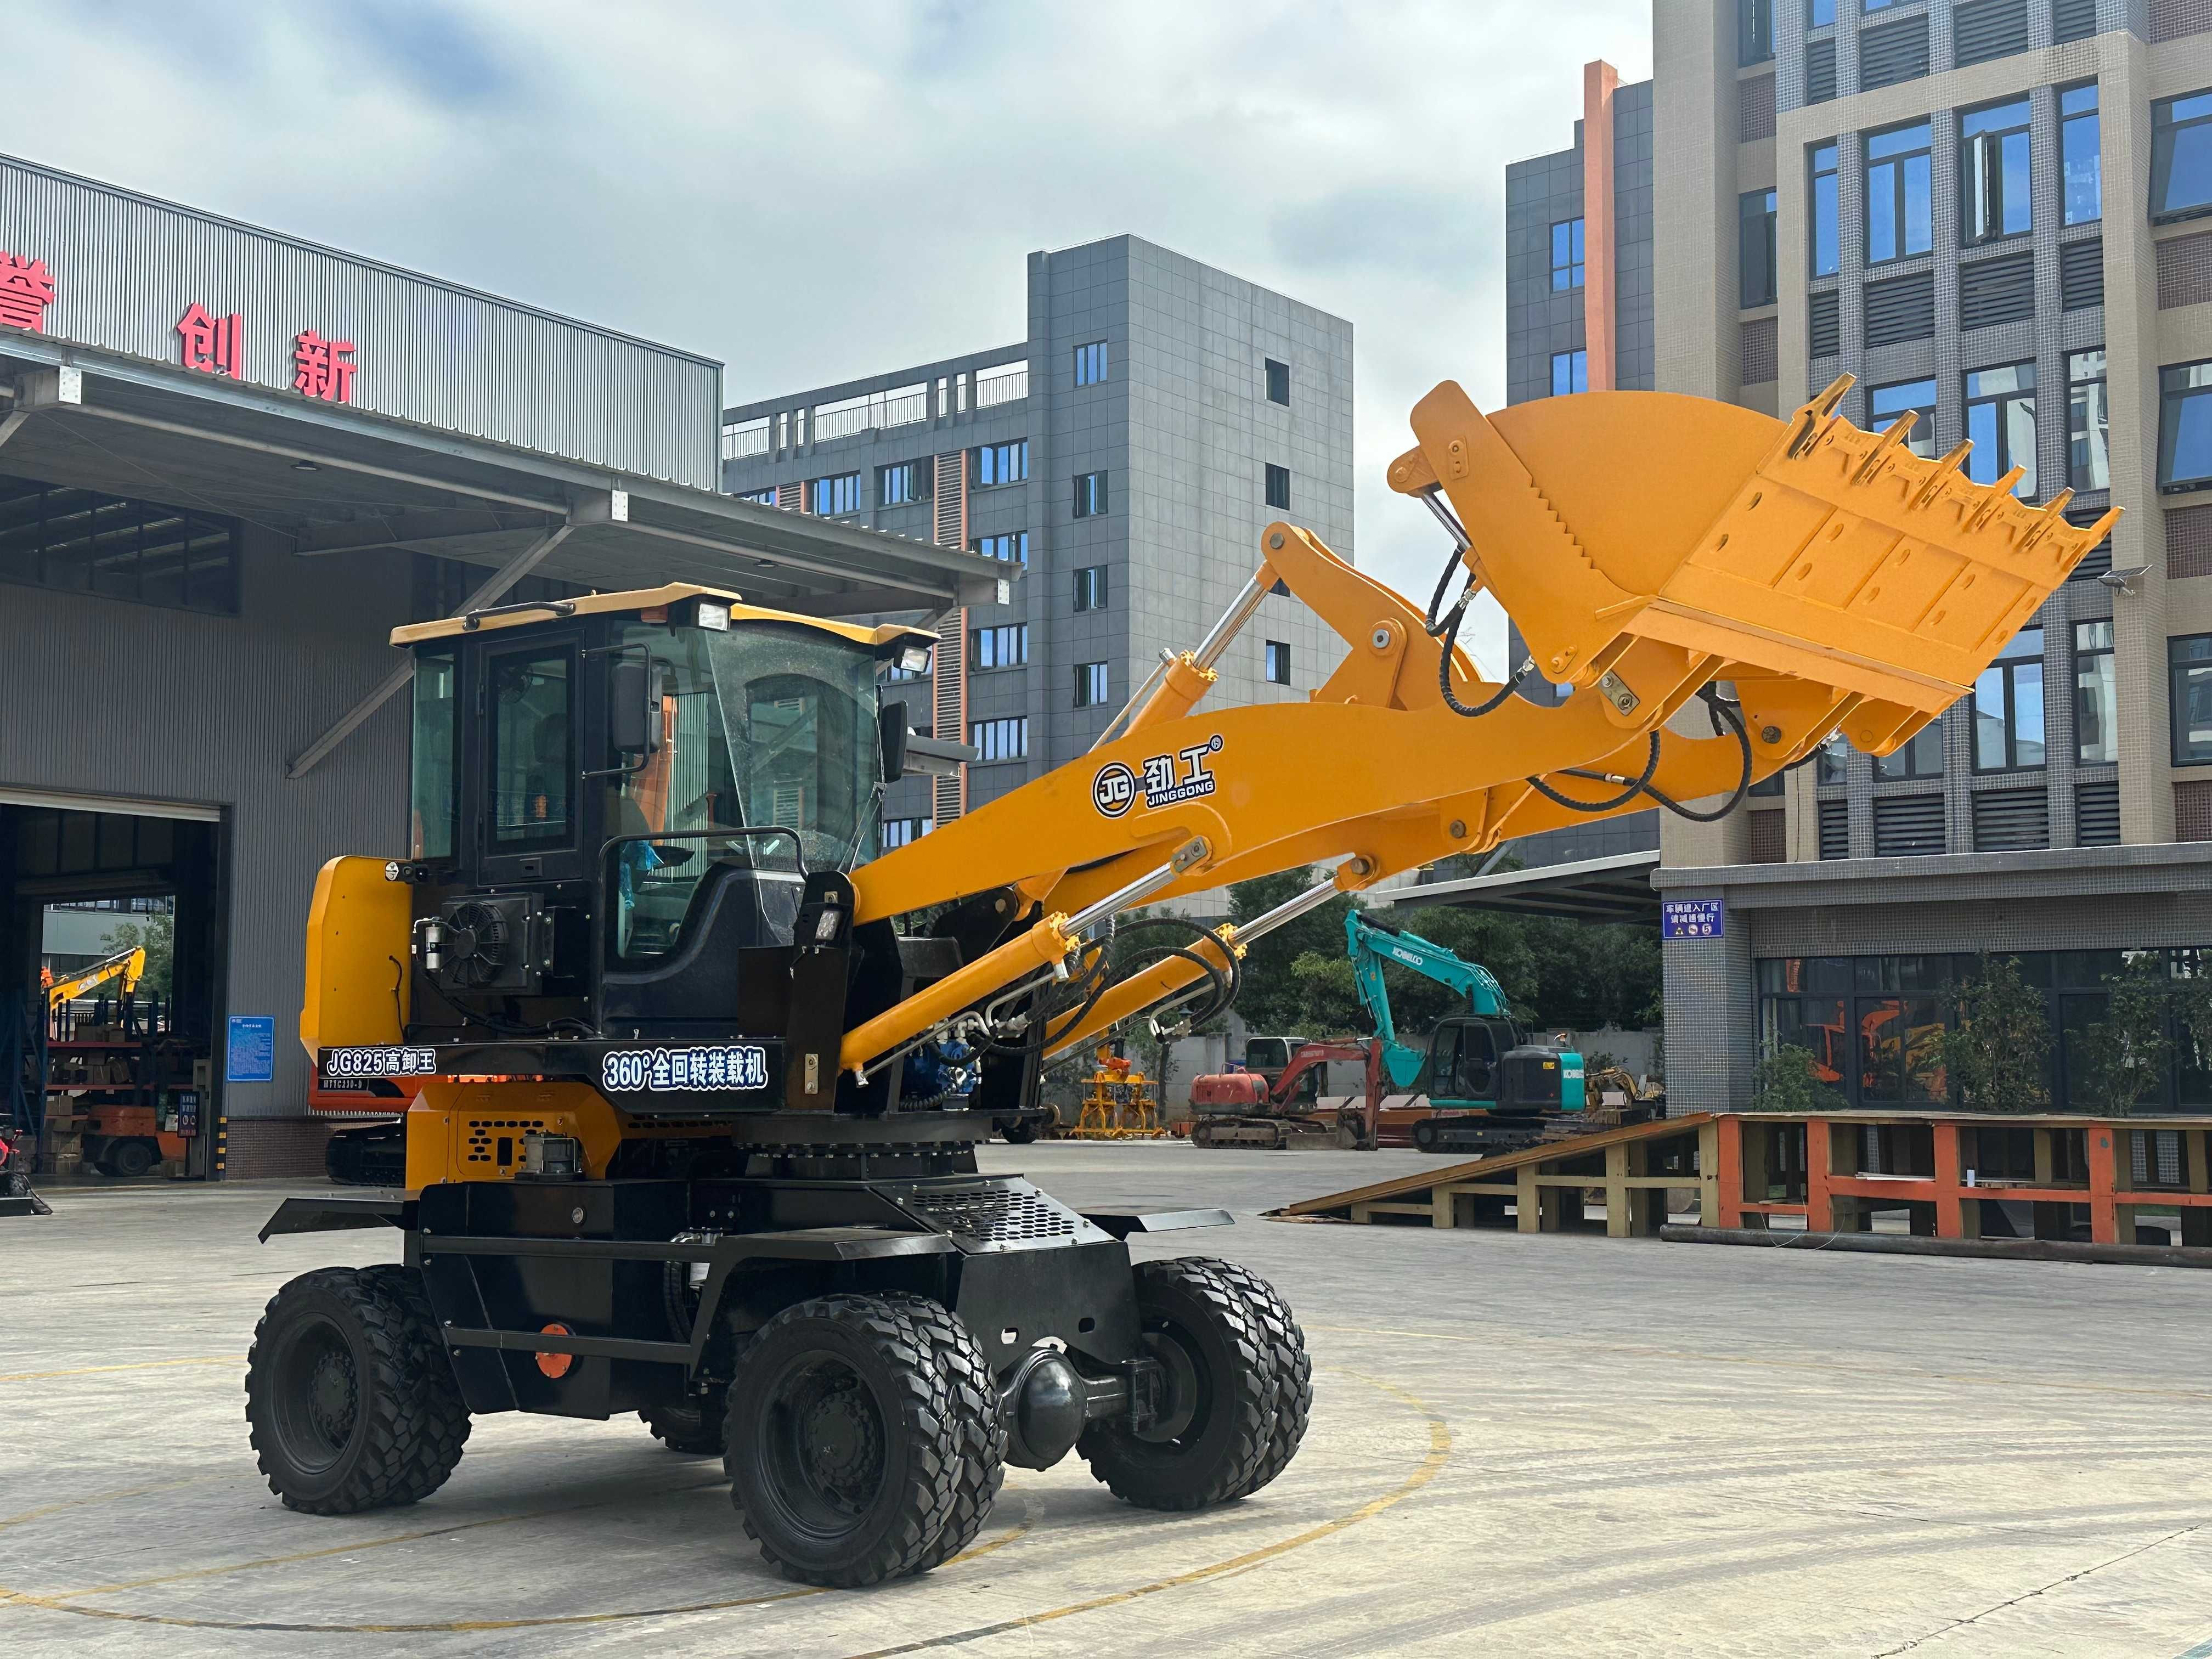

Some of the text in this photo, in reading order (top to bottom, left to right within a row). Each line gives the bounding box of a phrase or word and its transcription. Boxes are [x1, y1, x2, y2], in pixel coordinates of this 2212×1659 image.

[177, 303, 358, 404] 创新
[1144, 746, 1214, 795] 劲工
[1148, 781, 1214, 806] JINGGONG
[329, 1051, 435, 1073] JG825高卸王
